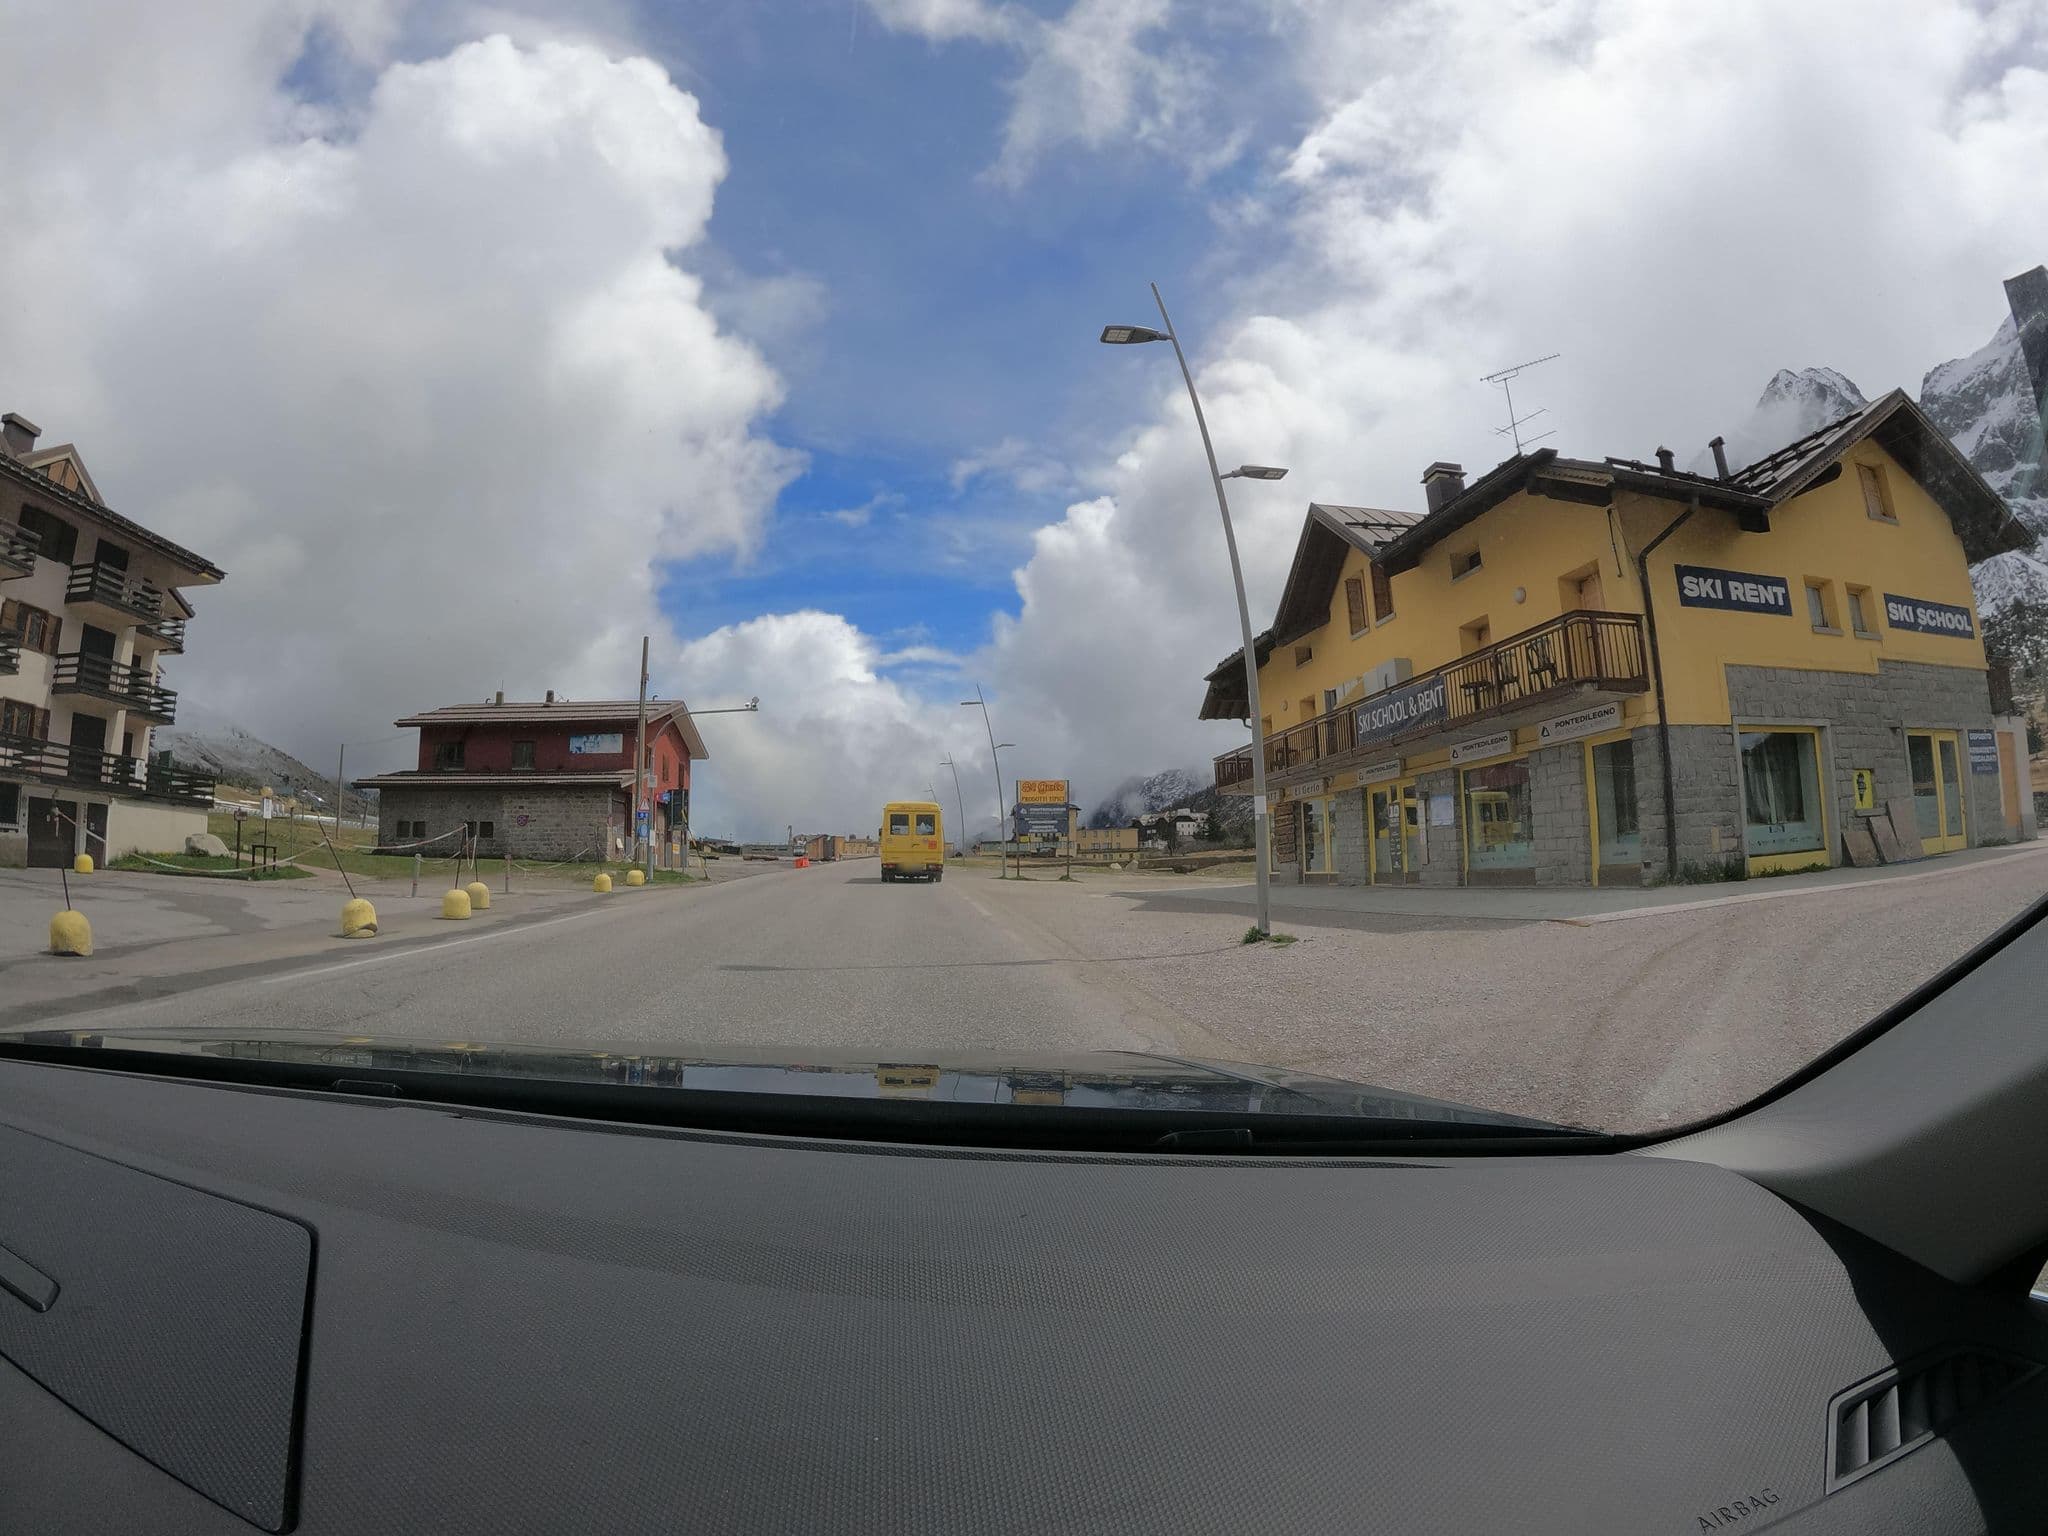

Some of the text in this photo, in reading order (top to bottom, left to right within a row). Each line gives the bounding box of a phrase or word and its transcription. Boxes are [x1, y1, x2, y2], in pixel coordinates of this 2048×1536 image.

[1682, 575, 1786, 606] SKI RENT
[1887, 602, 1973, 632] SKI SCHOOL
[1358, 685, 1444, 734] SKI SCHOOL & RENT
[1554, 706, 1616, 729] PONTEDILEGNO
[1462, 735, 1509, 752] PONTEDILEGNO
[1697, 1488, 1780, 1535] AIRBAG
